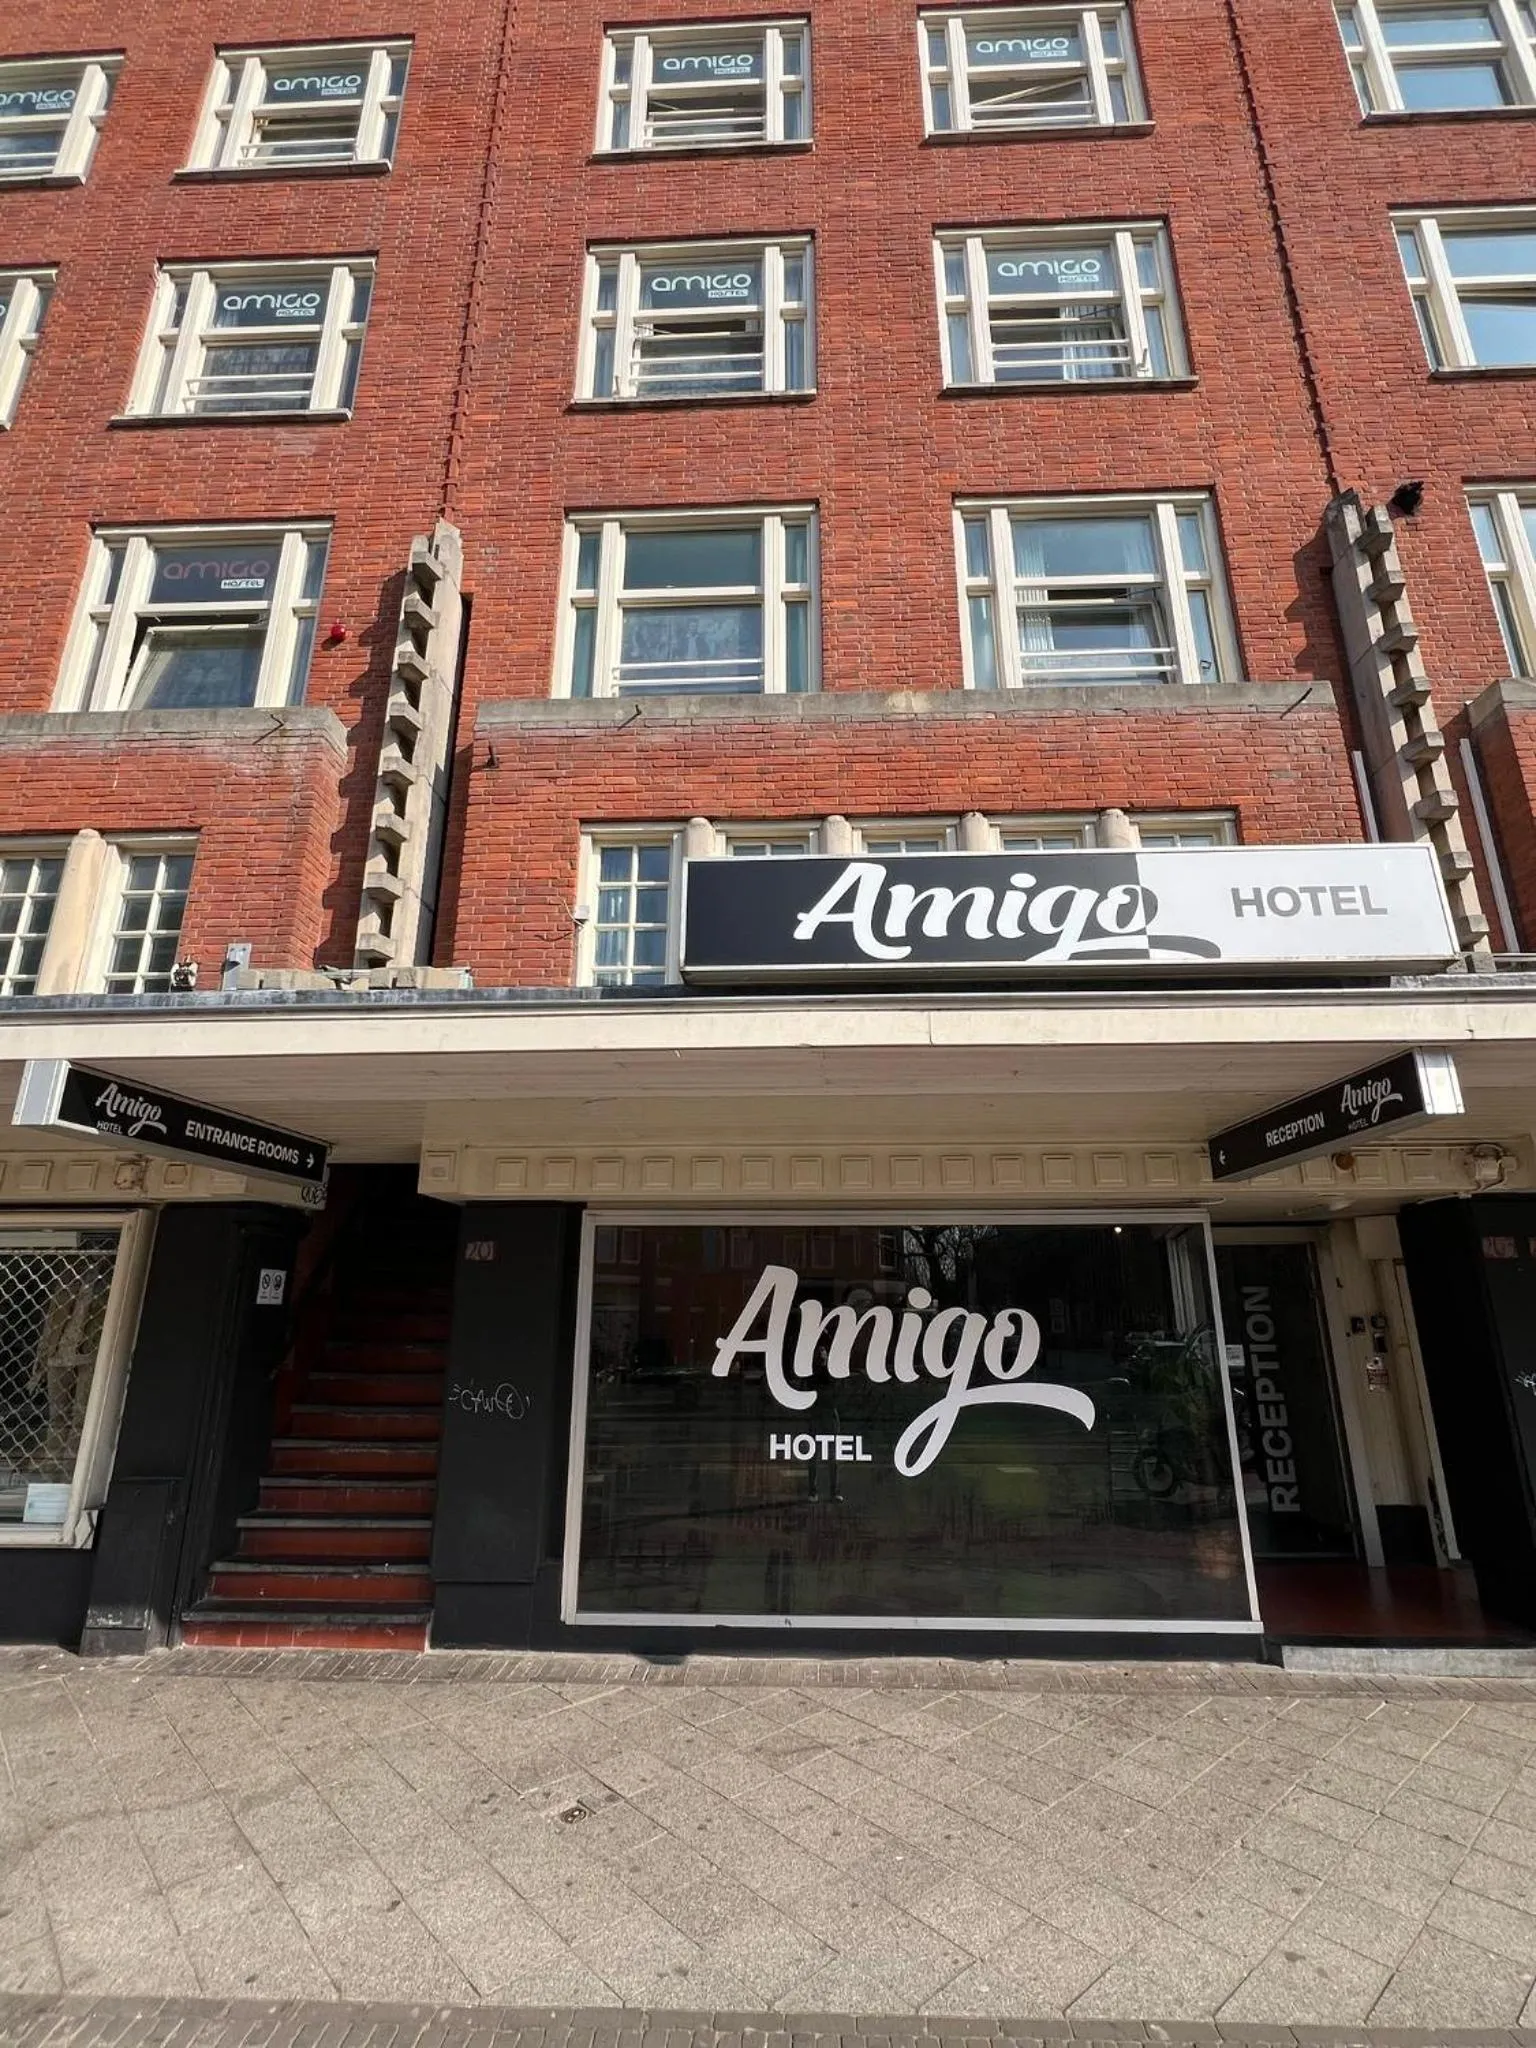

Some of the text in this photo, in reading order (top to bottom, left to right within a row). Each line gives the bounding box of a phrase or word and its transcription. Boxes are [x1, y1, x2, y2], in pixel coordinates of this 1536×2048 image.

[222, 579, 264, 588] HOSTEL
[793, 862, 1388, 960] Amigo HOTEL
[95, 1083, 167, 1136] Amigo
[1341, 1077, 1403, 1123] Amigo
[97, 1120, 124, 1135] HOTEL
[185, 1120, 299, 1165] ENTRANCE ROOMS
[1265, 1111, 1325, 1148] RECEPTION
[712, 1265, 1096, 1477] Amigo
[1241, 1286, 1301, 1512] RECEPTION
[769, 1433, 872, 1461] HOTEL
